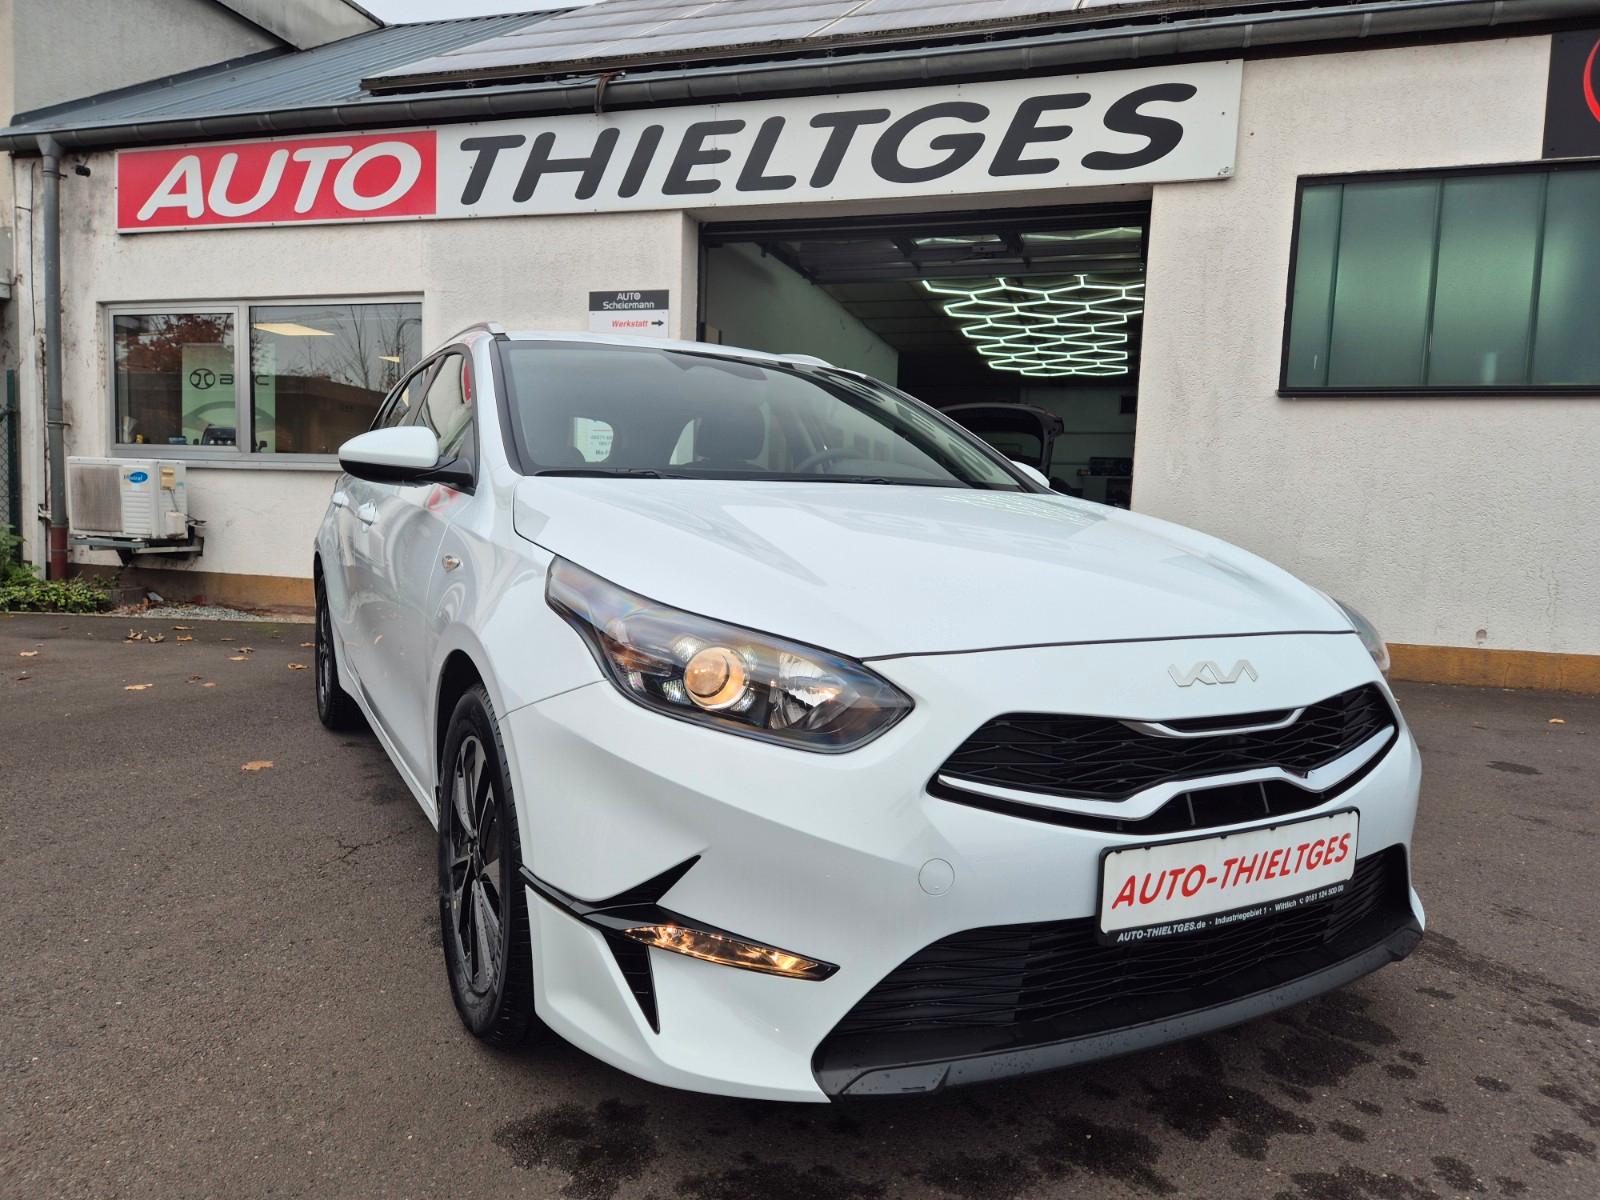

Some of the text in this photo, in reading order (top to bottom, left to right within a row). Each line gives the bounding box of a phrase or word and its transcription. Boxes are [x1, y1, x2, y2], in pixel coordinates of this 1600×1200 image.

[137, 83, 1197, 221] AUTO THIELTGES
[602, 300, 655, 310] Scheiermann
[616, 292, 641, 301] AUTO
[611, 320, 649, 328] Werkstatt
[1111, 832, 1352, 910] AUTO-THIELTGES
[1117, 920, 1206, 942] AUTO-THIELTGES.de
[1214, 906, 1263, 925] Industriegebiet
[1274, 899, 1297, 912] Wittlich
